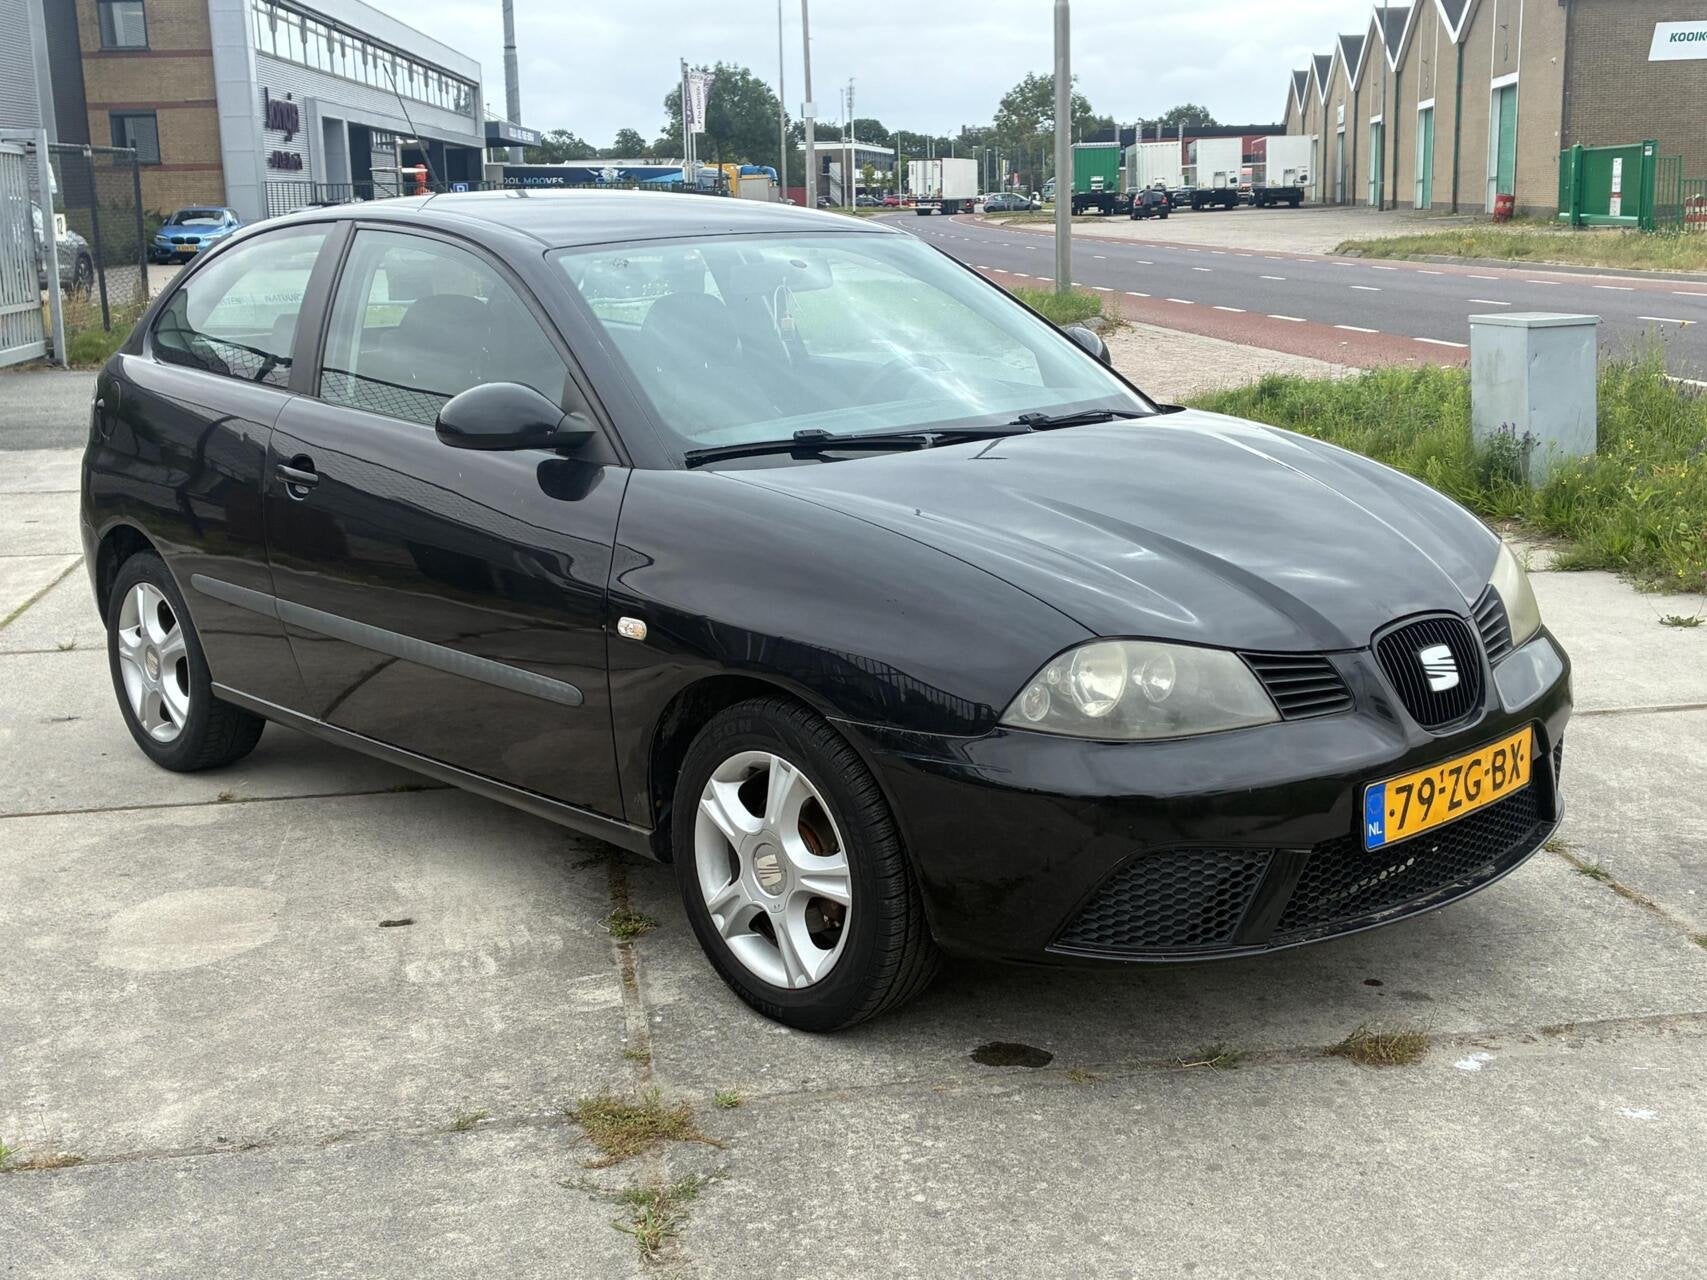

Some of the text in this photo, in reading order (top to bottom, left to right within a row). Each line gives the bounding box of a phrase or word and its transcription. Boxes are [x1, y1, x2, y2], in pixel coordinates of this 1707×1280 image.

[1670, 32, 1707, 42] KOOIK
[1368, 739, 1523, 837] NL 79-ZG-BX
